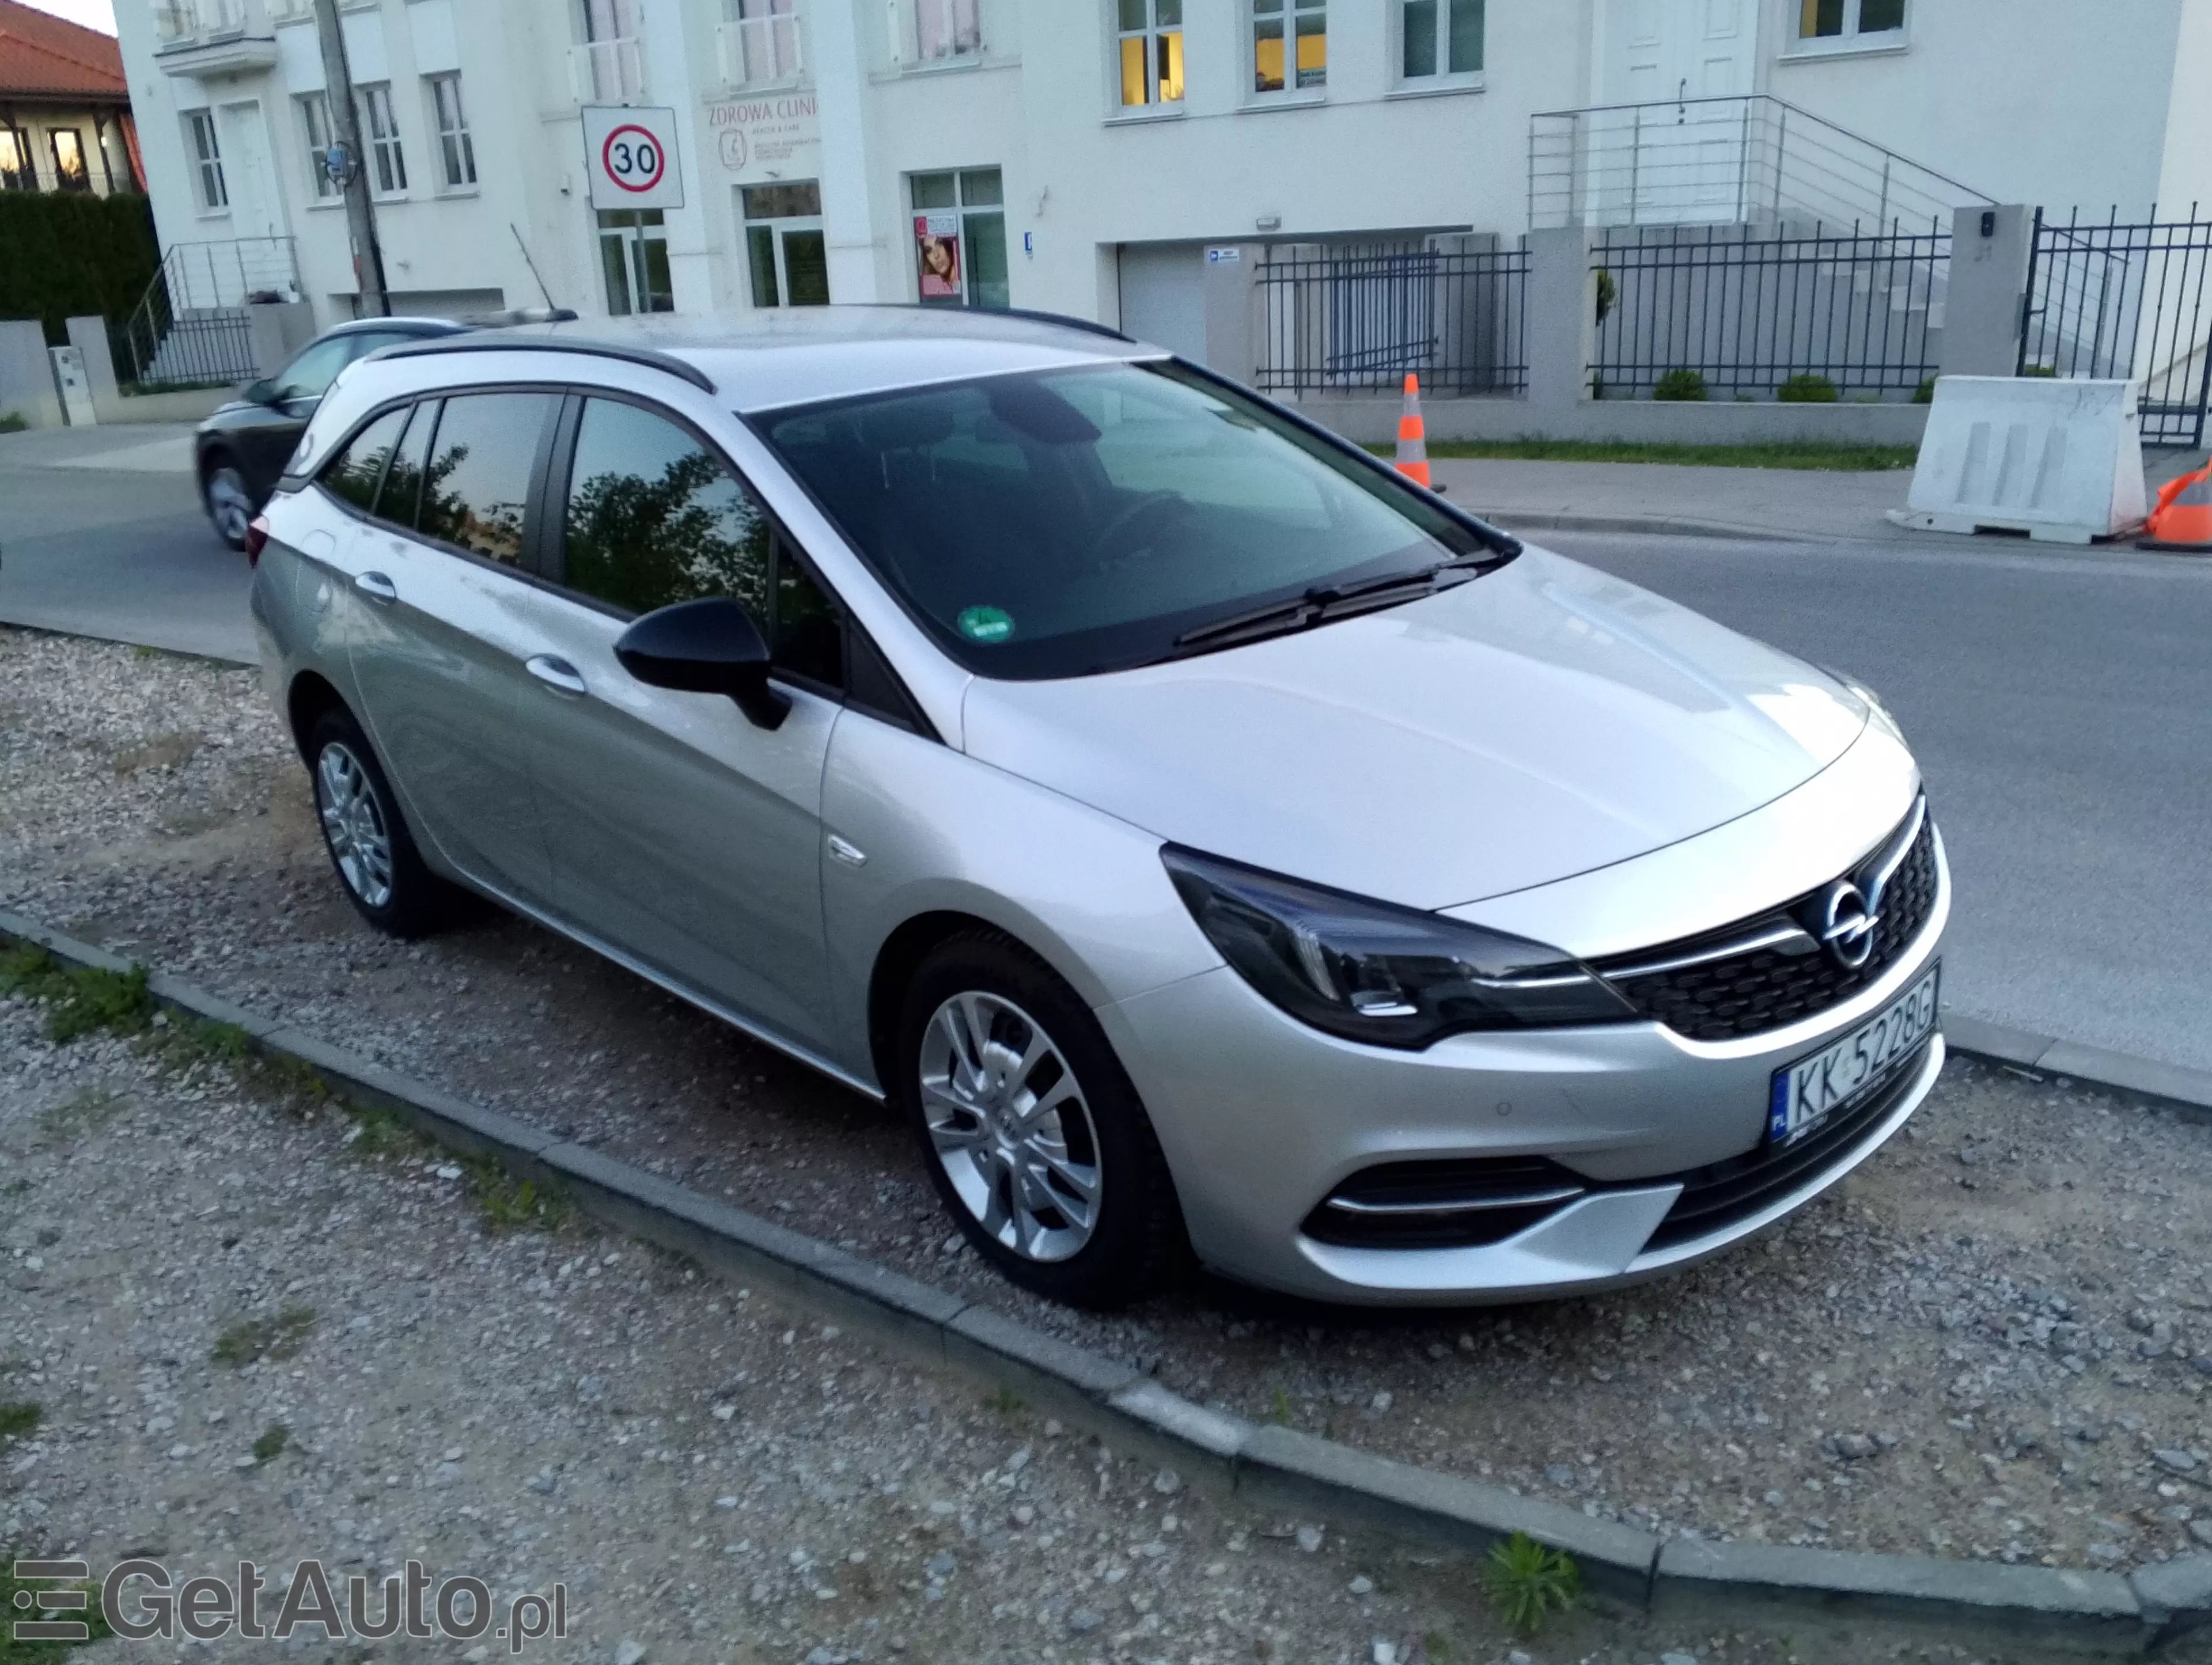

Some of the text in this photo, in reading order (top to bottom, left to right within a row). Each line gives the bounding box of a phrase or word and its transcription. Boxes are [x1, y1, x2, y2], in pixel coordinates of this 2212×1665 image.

[708, 97, 819, 127] ZDROWA CLINI
[613, 142, 656, 174] 30
[1796, 980, 1932, 1124] KK 5228G
[1771, 1113, 1787, 1132] PL
